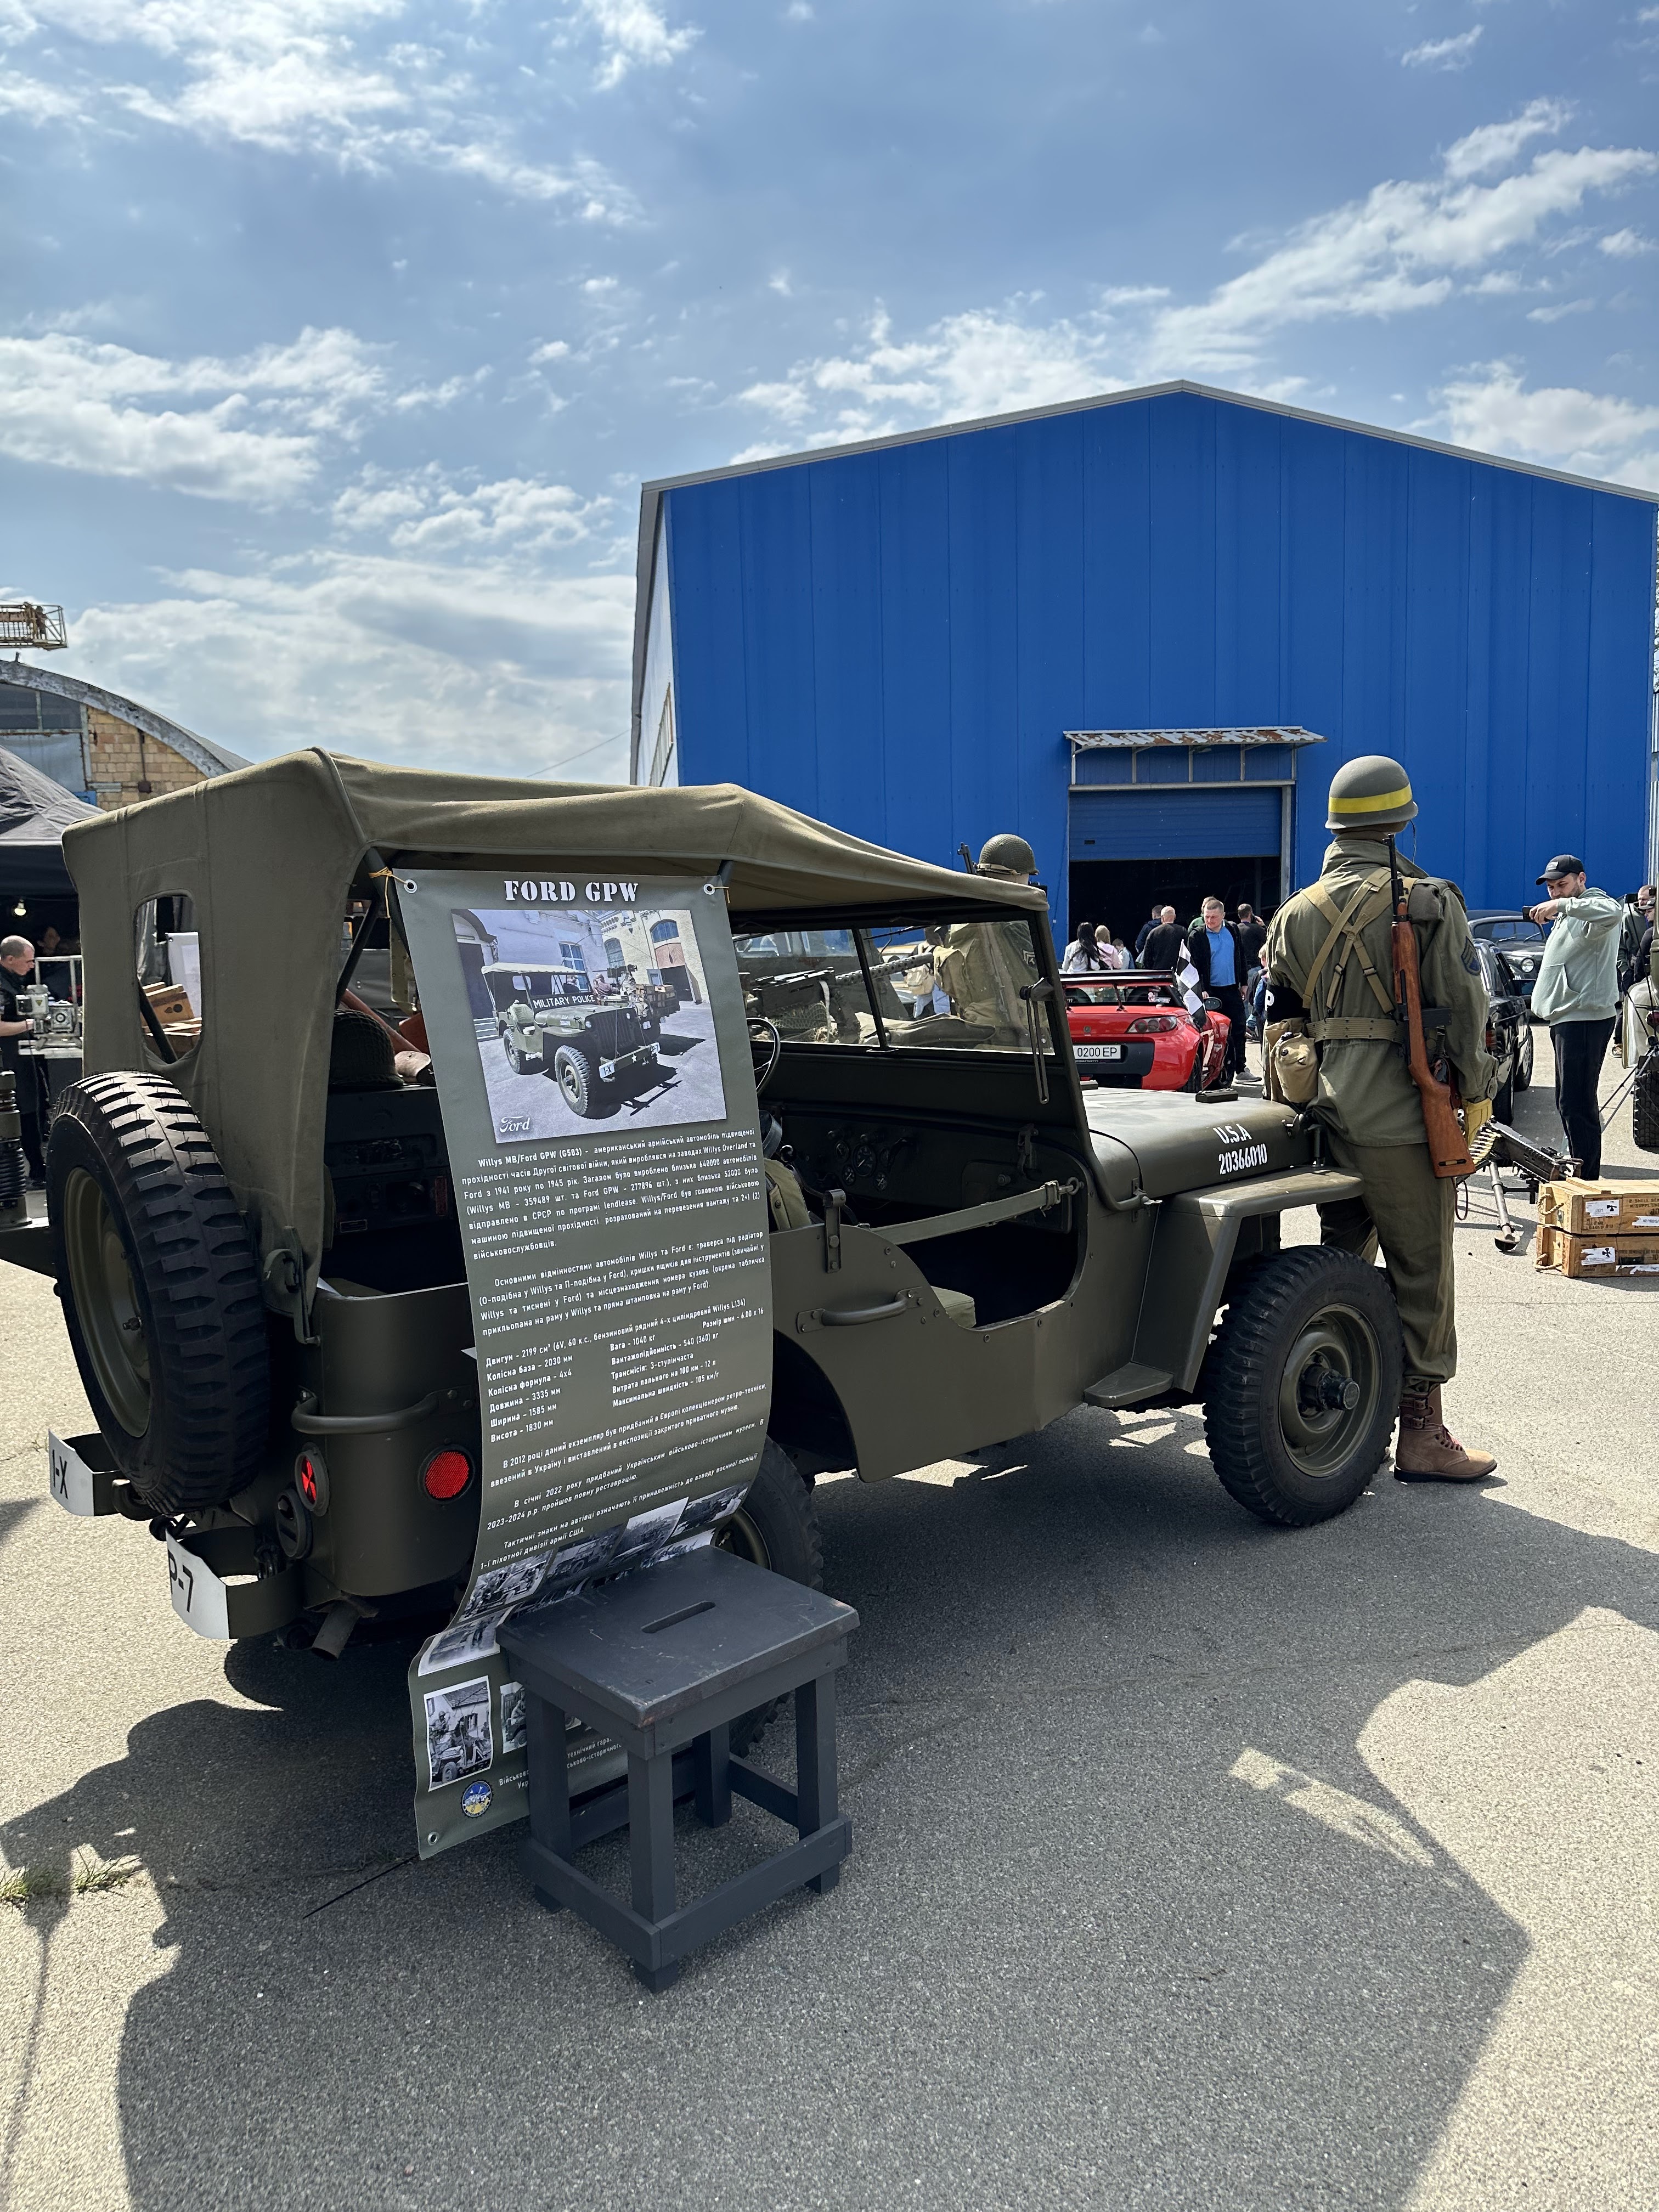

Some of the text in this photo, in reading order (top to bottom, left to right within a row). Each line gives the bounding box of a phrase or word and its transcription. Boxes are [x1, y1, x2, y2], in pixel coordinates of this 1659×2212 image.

[504, 881, 639, 901] FORD GPW
[532, 995, 596, 1009] MILITARY POLICE
[1077, 1047, 1118, 1057] 0200 EP
[499, 1115, 531, 1133] Ford
[478, 1128, 755, 1167] Willys MB/Ford GPW (G503) американський армійський автомобіль підвищеної
[1218, 1143, 1268, 1175] 20366010
[464, 1189, 482, 1200] Ford
[494, 1186, 510, 1195] 1941
[514, 1185, 531, 1195] року
[548, 1178, 563, 1188] 1945
[583, 1174, 612, 1183] Загалом
[615, 1172, 631, 1181] було
[634, 1167, 668, 1177] вироблено
[672, 1163, 697, 1171] близька
[699, 1158, 720, 1168] 640000
[723, 1154, 757, 1165] автомобілів
[467, 1204, 494, 1216] (Willys
[498, 1201, 510, 1210] MB
[524, 1195, 550, 1206] 359489
[583, 1188, 599, 1198] Ford
[603, 1186, 618, 1195] GPW
[630, 1181, 652, 1191] 277896
[697, 1173, 721, 1182] близька
[724, 1169, 741, 1177] 52000
[744, 1167, 758, 1176] було
[473, 1240, 556, 1260] військовослужбовців.
[494, 1273, 537, 1286] Основними
[540, 1263, 592, 1278] відмінностями
[596, 1255, 636, 1268] автомобілів
[639, 1251, 658, 1260] Willys
[671, 1244, 685, 1254] Ford
[696, 1239, 724, 1250] траверса
[738, 1232, 763, 1243] радіатор
[483, 1319, 533, 1337] прикльопана
[546, 1313, 563, 1324] раму
[565, 1312, 569, 1320] у
[571, 1307, 592, 1317] Willys
[603, 1300, 624, 1311] пряма
[625, 1292, 661, 1305] штамповка
[672, 1286, 686, 1296] раму
[486, 1355, 513, 1368] Двигун
[522, 1347, 537, 1358] 2199
[568, 1338, 576, 1347] 60
[594, 1324, 633, 1341] бензиновий
[635, 1318, 658, 1333] рядний
[672, 1306, 711, 1323] циліндровий
[712, 1304, 730, 1313] Willys
[731, 1297, 746, 1308] L134)
[610, 1342, 625, 1351] Вага
[633, 1335, 647, 1346] 1040
[611, 1344, 676, 1365] Вантажопідйомність
[683, 1337, 695, 1347] 540
[696, 1333, 710, 1345] (360)
[487, 1369, 516, 1382] Колісна
[518, 1364, 535, 1374] база
[544, 1356, 561, 1368] 2030
[611, 1353, 693, 1381] Трансмісія: 3-ступінчаста
[612, 1381, 639, 1394] Витрата
[640, 1373, 669, 1386] пального
[680, 1365, 689, 1374] 100
[488, 1384, 517, 1397] Колісна
[520, 1375, 551, 1390] формула
[613, 1370, 719, 1407] Максимальна швидкість 105 км/г
[489, 1398, 523, 1414] Довжина
[532, 1389, 549, 1401] 3335
[490, 1403, 557, 1427] Ширина 1585 мм
[490, 1430, 517, 1443] Висота
[526, 1421, 541, 1432] 1830
[503, 1460, 508, 1469] В
[510, 1454, 526, 1466] 2012
[528, 1449, 543, 1463] році
[544, 1441, 566, 1457] даний
[568, 1432, 604, 1448] екземпляр
[606, 1429, 617, 1437] був
[618, 1415, 653, 1434] придбаний
[660, 1409, 680, 1420] Європі
[681, 1396, 725, 1413] колекціонером
[726, 1384, 766, 1402] ретро-техніки,
[487, 1511, 525, 1530] 2023-2024
[541, 1496, 572, 1511] пройшов
[574, 1488, 594, 1500] повну
[492, 1549, 523, 1566] піхотної
[523, 1539, 549, 1555] дивізії
[549, 1532, 568, 1545] армії
[597, 1737, 612, 1748] гара
